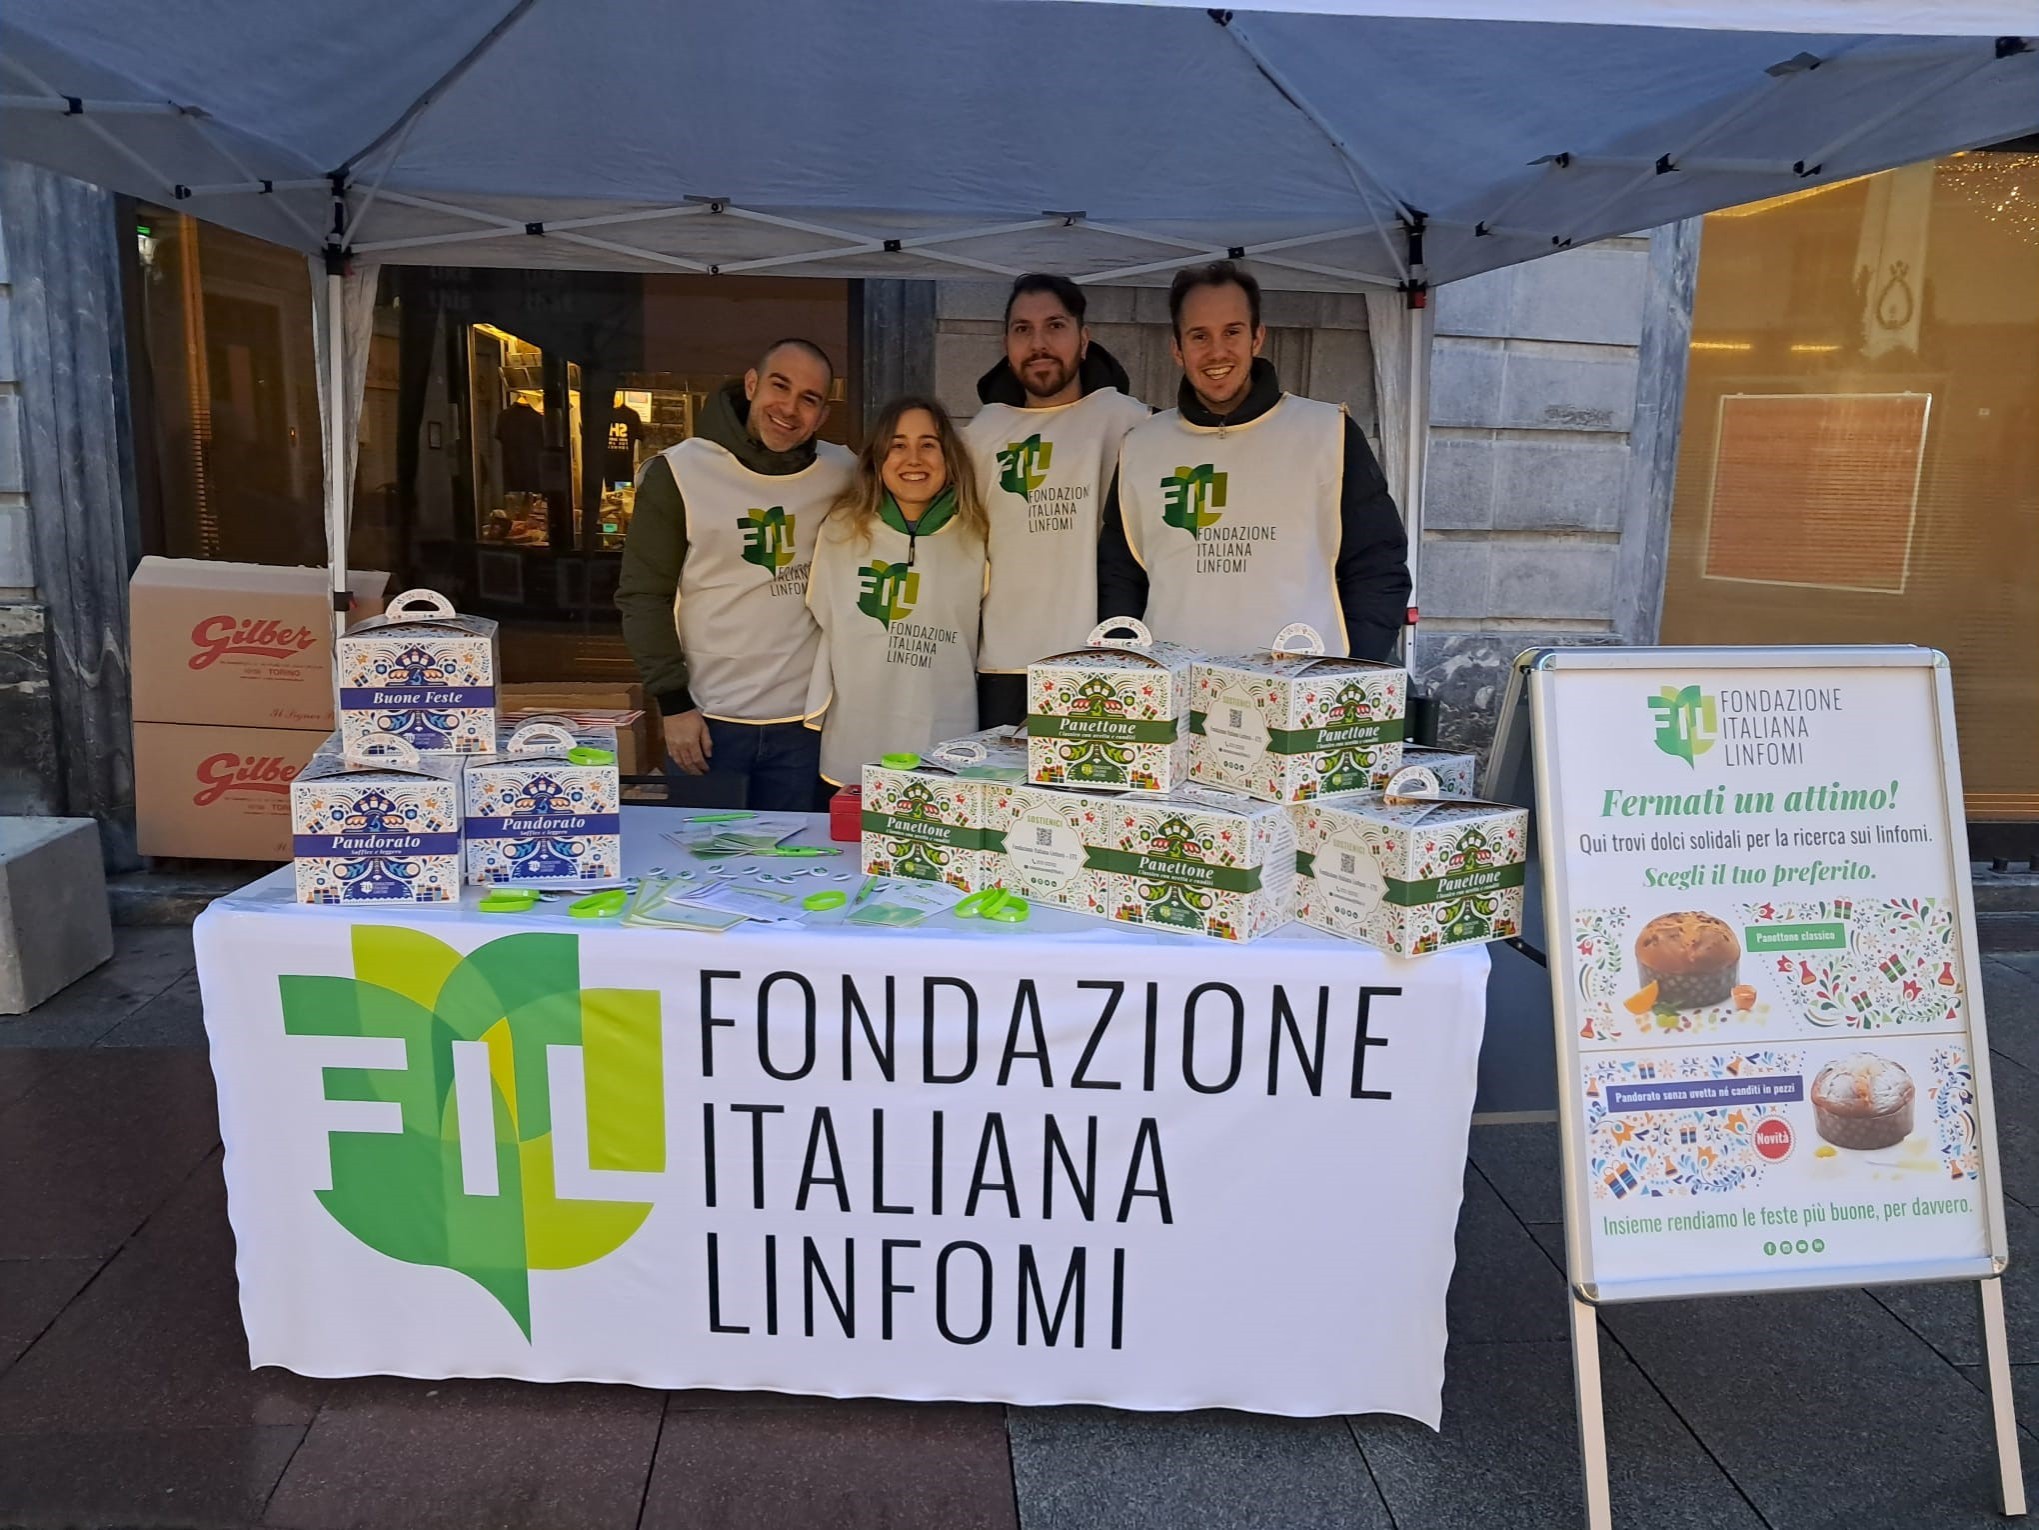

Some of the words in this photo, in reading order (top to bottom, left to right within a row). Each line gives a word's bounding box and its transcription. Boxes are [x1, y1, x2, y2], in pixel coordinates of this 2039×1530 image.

[1028, 502, 1077, 518] ITALIANA
[1028, 517, 1073, 533] LINFOMI
[1197, 526, 1277, 541] FONDAZIONE
[1197, 542, 1252, 557] ITALIANA
[1196, 558, 1247, 574] LINFOMI
[890, 621, 958, 644] FONDAZIONE
[188, 615, 317, 671] Gilber
[888, 635, 937, 655] ITALIANA
[886, 650, 932, 668] LINFOMI
[373, 691, 420, 704] Buone
[425, 691, 463, 704] Feste
[1720, 688, 1843, 712] FONDAZIONE
[1059, 718, 1136, 734] Panettone
[1317, 726, 1380, 742] Panettone
[1722, 716, 1809, 740] ITALIANA
[1725, 742, 1803, 766] LINFOMI
[1600, 784, 1726, 817] Fermati
[1734, 792, 1774, 814] un
[1784, 780, 1899, 812] attimo!
[502, 816, 586, 830] Pandorato
[887, 816, 951, 838] Panettone
[332, 834, 420, 849] Pandorato
[1579, 833, 1607, 856] Qui
[1612, 832, 1646, 852] trovi
[1651, 832, 1686, 851] dolci
[1690, 830, 1741, 850] solidali
[1746, 832, 1770, 852] per
[1775, 828, 1788, 846] la
[1794, 828, 1846, 846] ricerca
[1850, 826, 1871, 845] sui
[1876, 824, 1933, 844] linfomi.
[1139, 856, 1214, 879] Panettone
[1642, 864, 1705, 890] Scegli
[1711, 864, 1726, 885] il
[1732, 866, 1767, 884] tuo
[1772, 859, 1876, 887] preferito.
[1438, 871, 1501, 892] Panettone
[1756, 932, 1799, 943] Panettone
[1801, 931, 1835, 940] classico
[700, 969, 1402, 1100] FONDAZIONE
[1616, 1092, 1661, 1103] Pandorato
[1663, 1092, 1687, 1100] senza
[1690, 1088, 1717, 1099] uvetta
[1719, 1086, 1729, 1097] né
[1731, 1084, 1761, 1096] canditi
[1762, 1084, 1772, 1094] in
[1774, 1083, 1795, 1096] pezzi
[1757, 1131, 1789, 1145] Novità
[703, 1102, 1174, 1225] ITALIANA
[1604, 1216, 1662, 1236] Insieme
[1668, 1210, 1738, 1231] rendiamo
[1743, 1207, 1756, 1226] le
[1760, 1206, 1798, 1225] feste
[1804, 1203, 1826, 1227] più
[1830, 1202, 1880, 1222] buone,
[1884, 1202, 1907, 1222] per
[1912, 1196, 1973, 1216] davvero.
[707, 1232, 1125, 1350] LINFOMI
